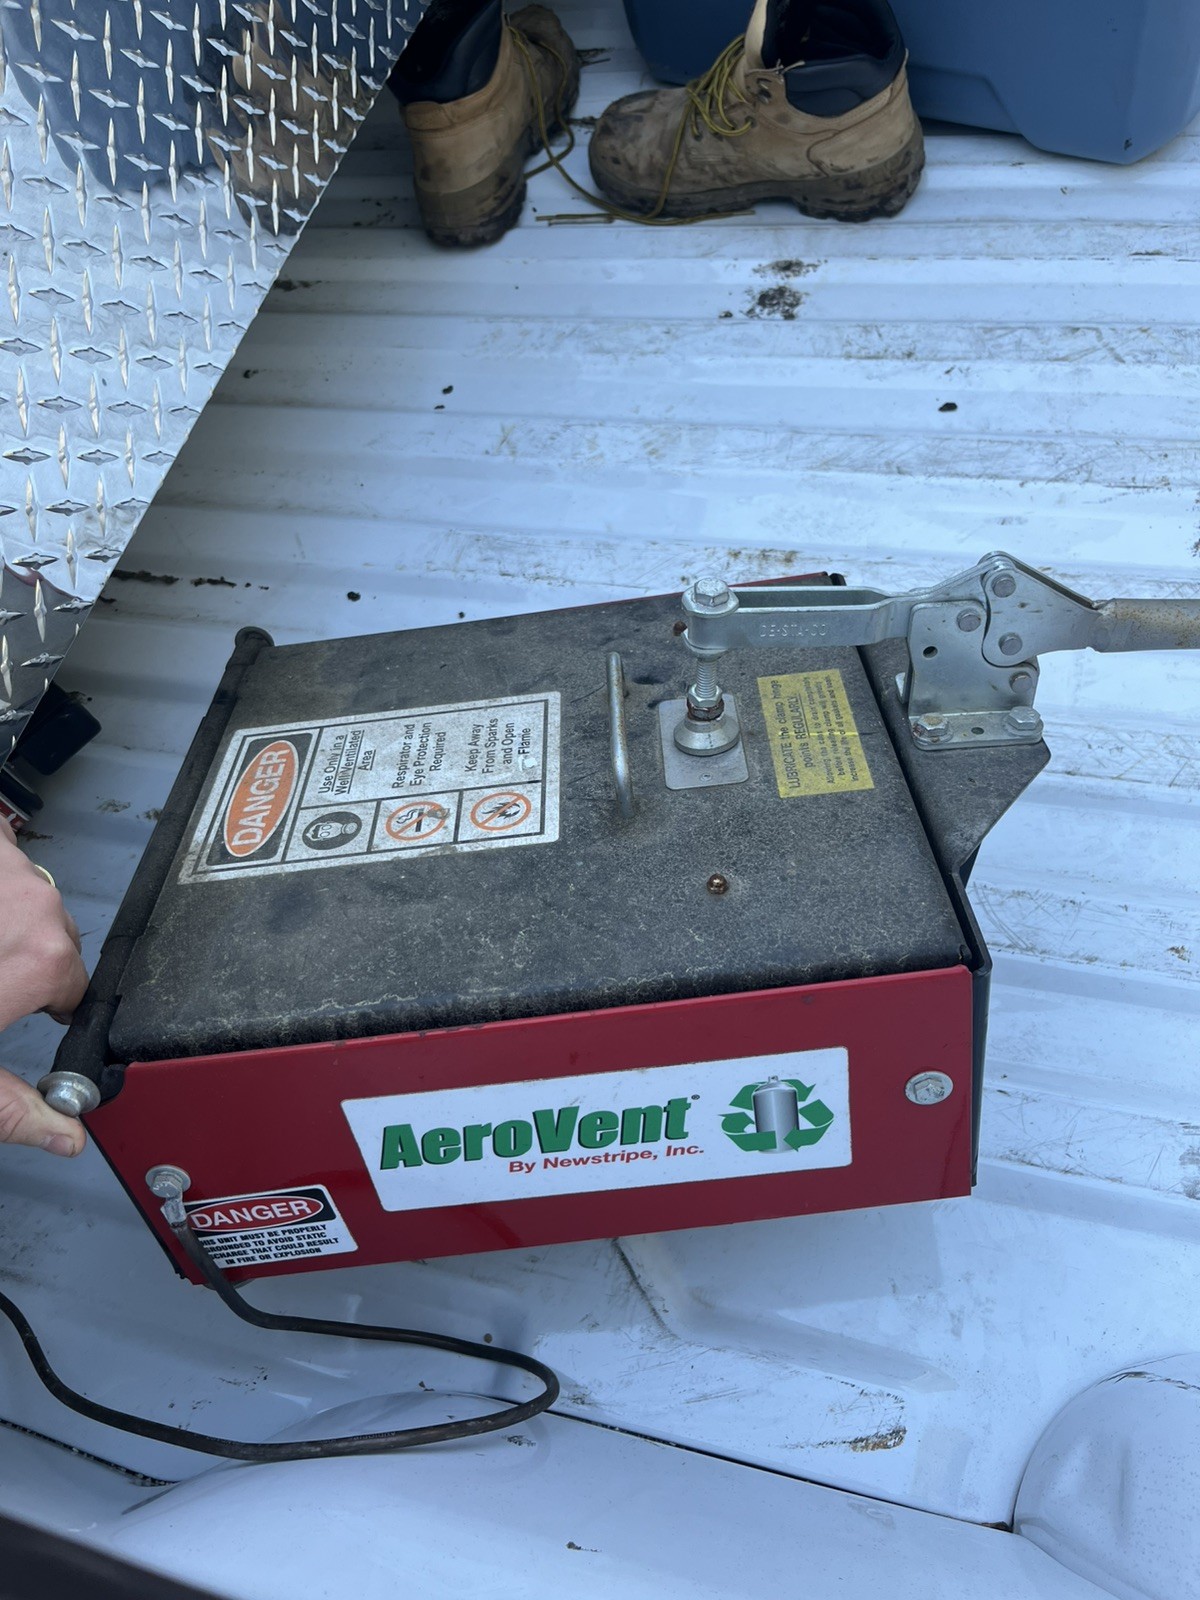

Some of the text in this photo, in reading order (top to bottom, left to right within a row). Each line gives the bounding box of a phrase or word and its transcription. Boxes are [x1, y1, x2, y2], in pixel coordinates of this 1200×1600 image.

[330, 742, 342, 751] in
[465, 724, 484, 772] Keep Away
[482, 718, 499, 774] From Sparks
[501, 722, 516, 764] and Open
[518, 728, 531, 755] Flame
[771, 680, 800, 789] LUBRICATE the clamp hinge
[324, 753, 340, 773] Only
[334, 730, 361, 795] Well Ventilated
[358, 750, 373, 770] Area
[392, 724, 415, 788] Respirator and
[409, 722, 432, 786] Eye Protection
[429, 732, 446, 771] Required
[800, 742, 816, 768] points
[231, 749, 290, 846] DANGER
[318, 775, 333, 793] Use
[380, 1097, 691, 1170] AeroVent
[509, 1144, 704, 1174] By Newstripe, Inc.
[190, 1200, 311, 1229] DANGER
[208, 1232, 327, 1253] ROUNDED TO AVOID STATIC
[217, 1236, 238, 1244] UNIT
[240, 1232, 265, 1241] MUST
[268, 1229, 280, 1237] BE
[282, 1224, 327, 1236] PROPERLY
[251, 1246, 273, 1254] THAT
[275, 1243, 305, 1251] COULD
[306, 1237, 339, 1247] RESULT
[237, 1255, 258, 1264] FIRE
[273, 1247, 322, 1259] EXPLOSION
